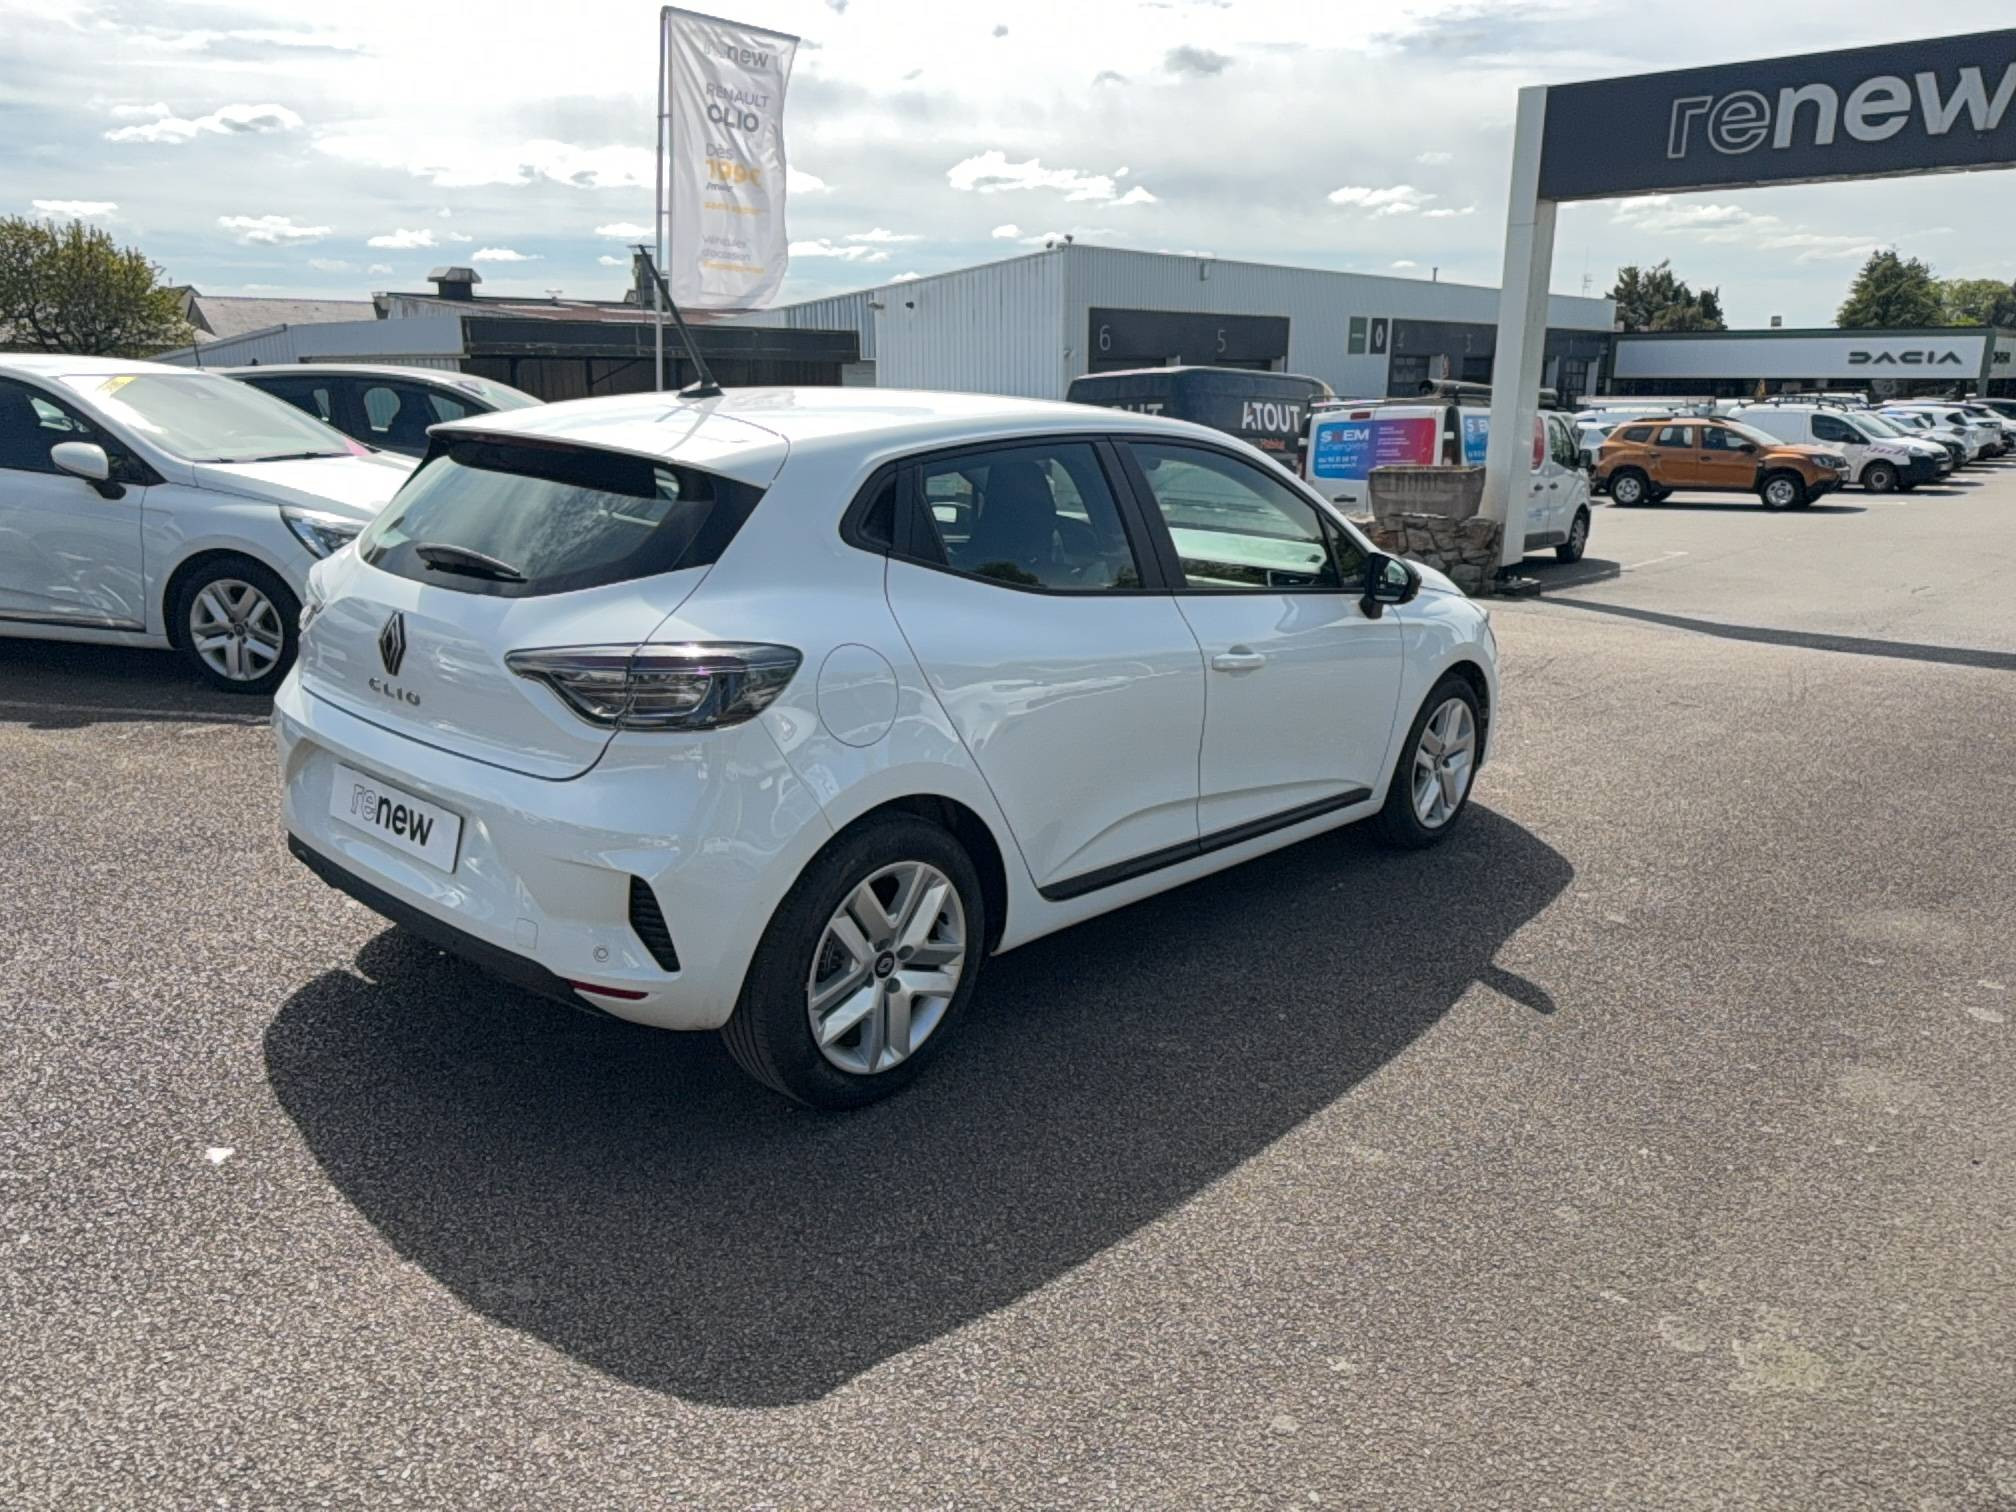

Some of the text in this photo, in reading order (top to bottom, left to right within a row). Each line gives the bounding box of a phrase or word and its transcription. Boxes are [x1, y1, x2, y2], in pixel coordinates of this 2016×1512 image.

[706, 83, 769, 107] RENAULT
[1667, 62, 2016, 159] renew
[706, 143, 735, 160] Dès
[1099, 324, 1111, 351] 6
[1216, 329, 1227, 353] 5
[1848, 351, 1962, 365] DACIA
[1242, 401, 1300, 433] ATOUT
[369, 677, 421, 706] CLIO
[350, 784, 434, 846] renew
